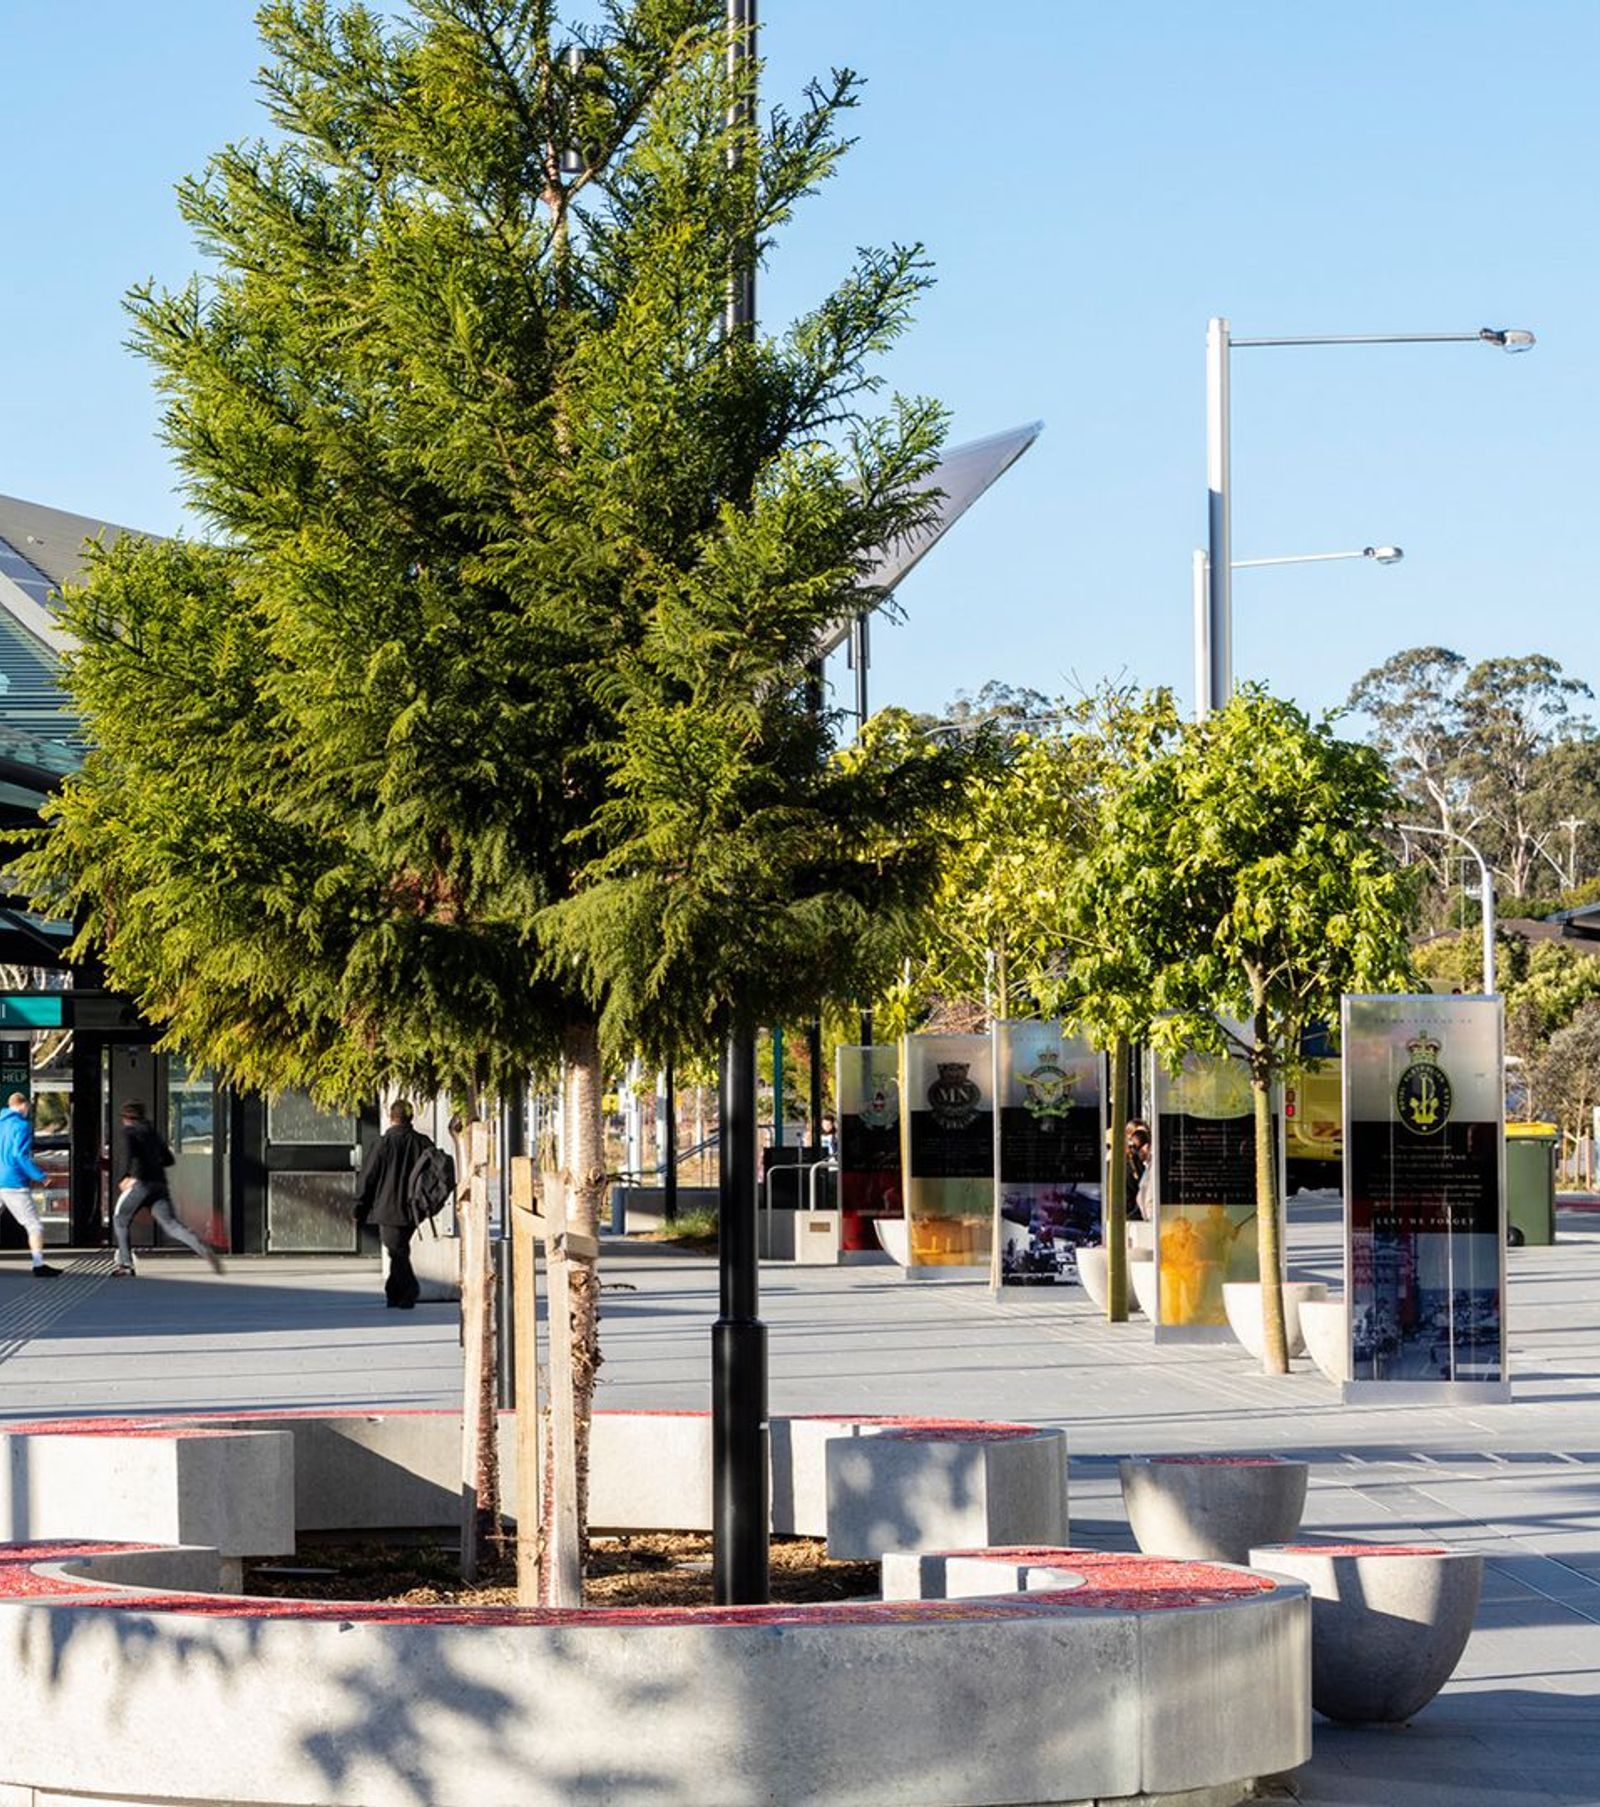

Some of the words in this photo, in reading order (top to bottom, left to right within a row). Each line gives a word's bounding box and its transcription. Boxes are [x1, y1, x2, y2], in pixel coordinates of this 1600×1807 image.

[1, 1072, 28, 1083] HELP
[1376, 1217, 1404, 1226] LEST
[1409, 1217, 1424, 1226] WE
[1430, 1217, 1475, 1226] FORGET
